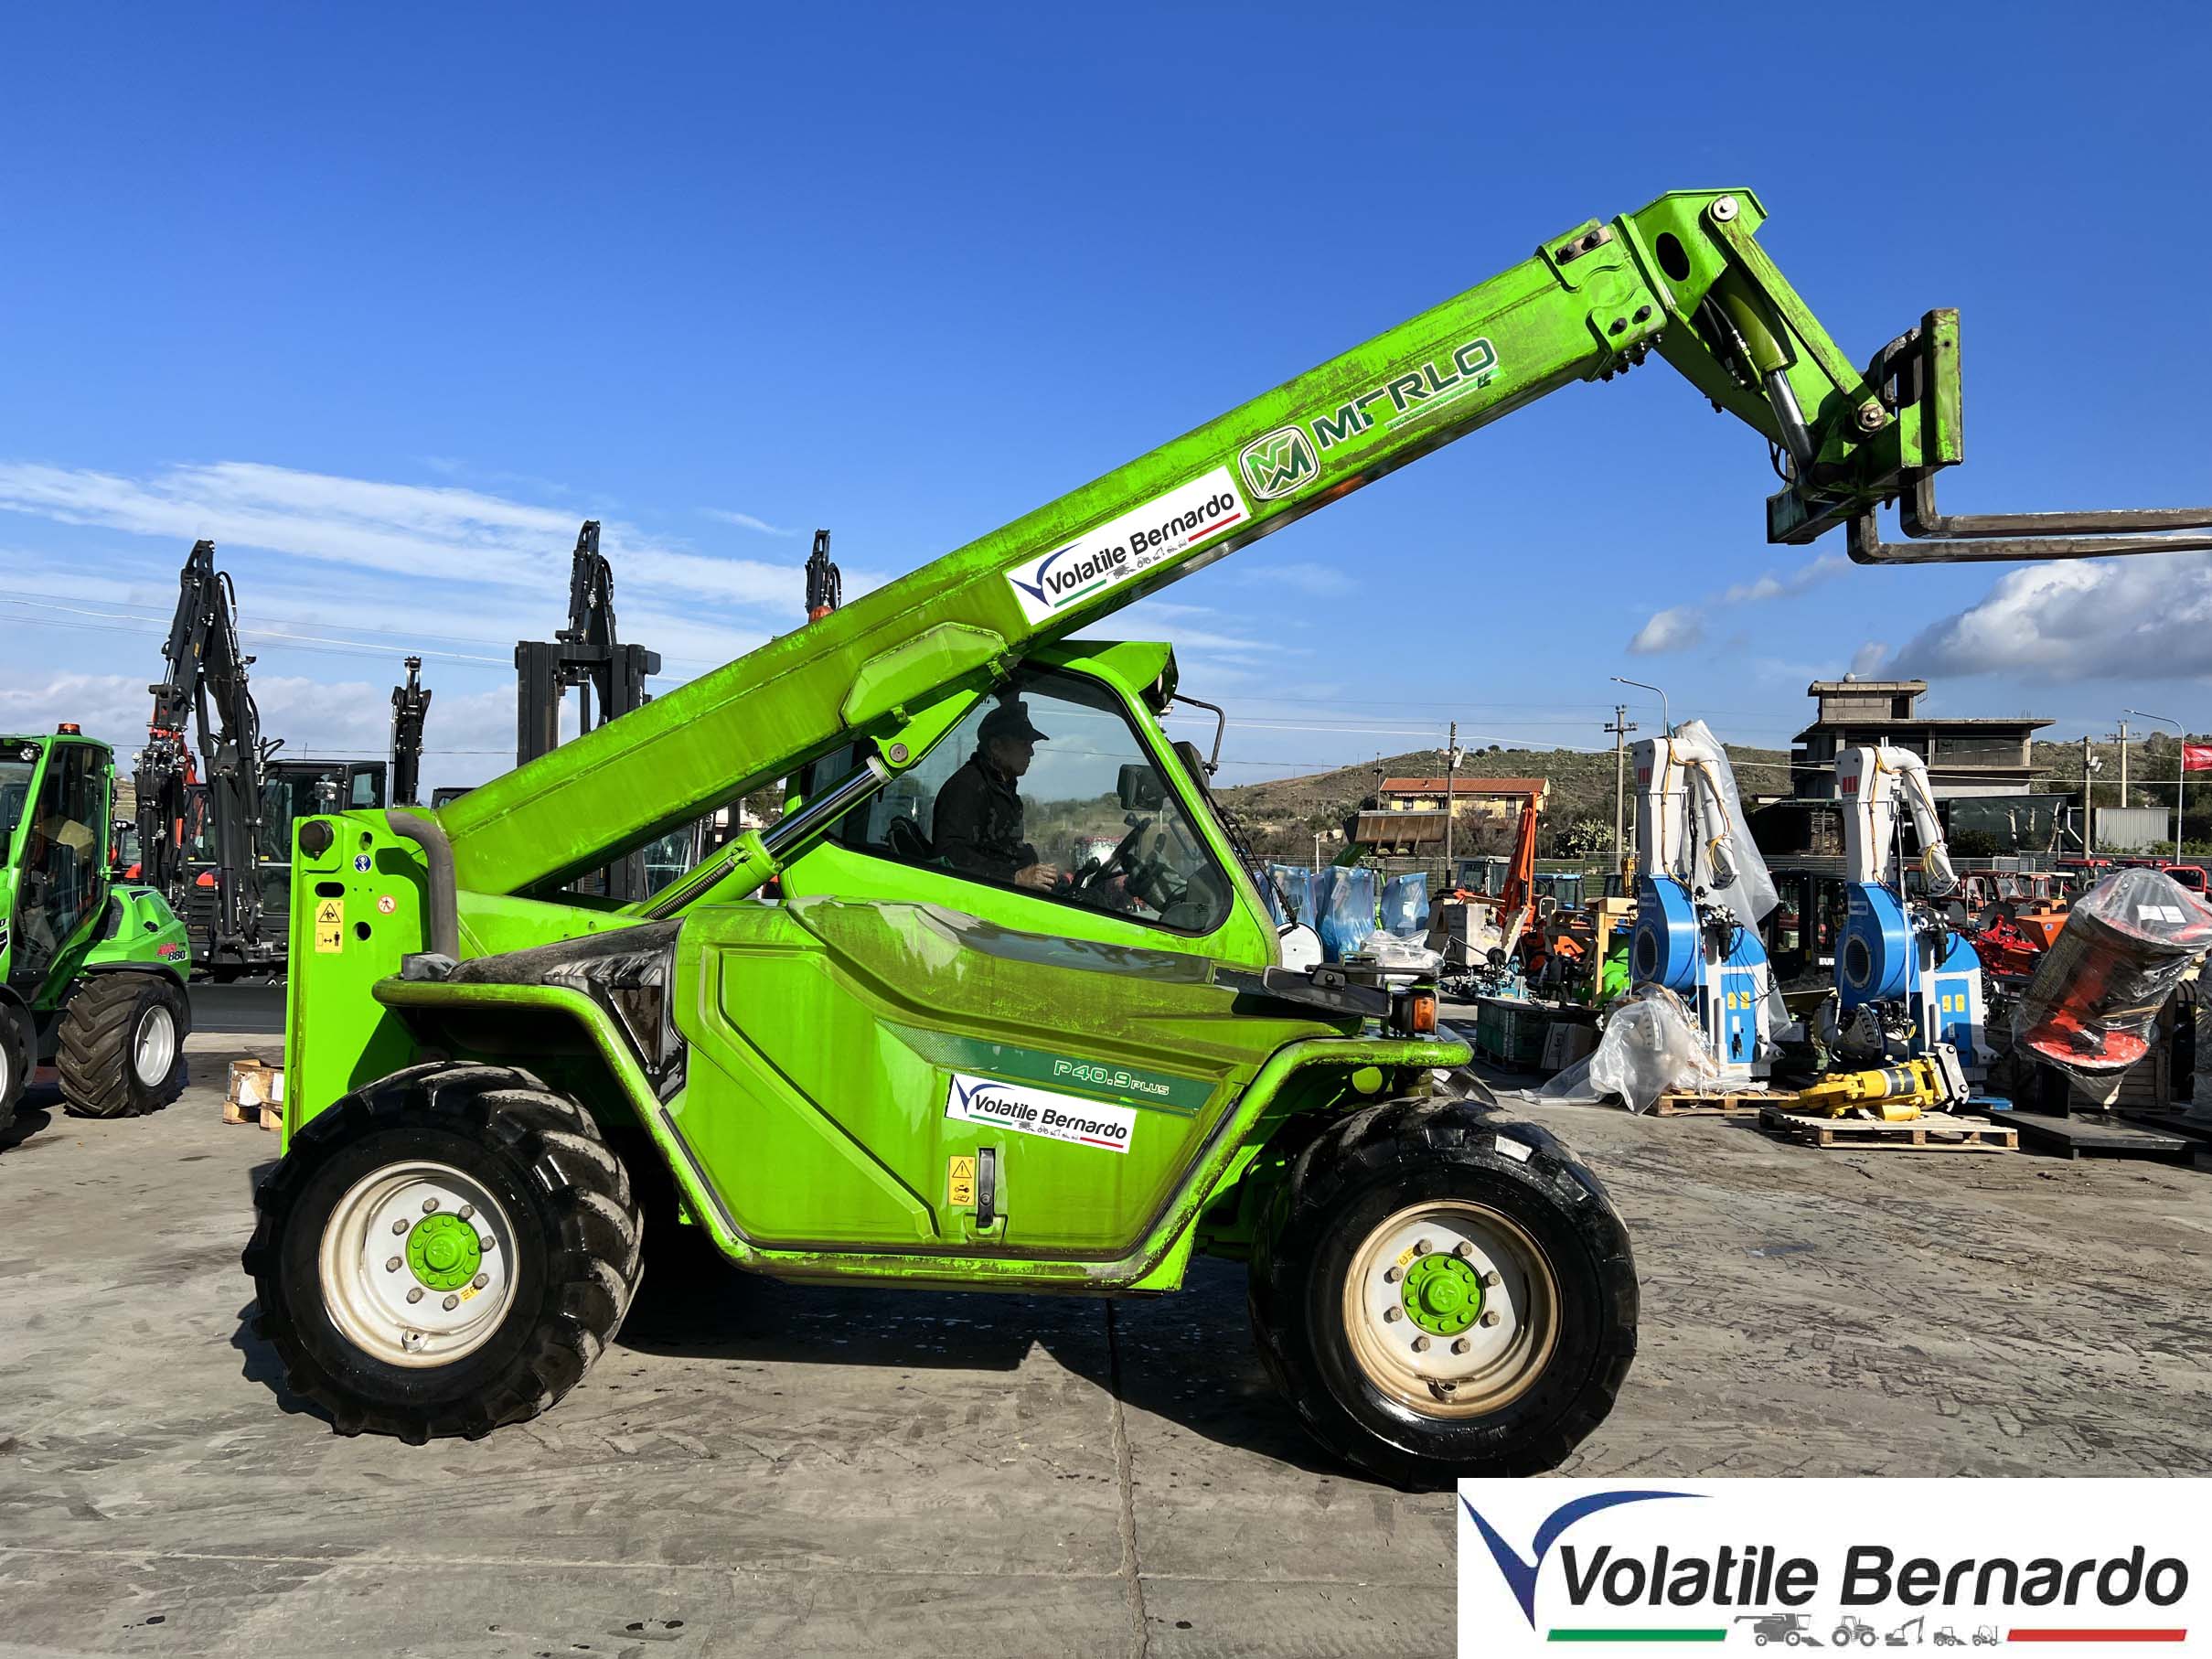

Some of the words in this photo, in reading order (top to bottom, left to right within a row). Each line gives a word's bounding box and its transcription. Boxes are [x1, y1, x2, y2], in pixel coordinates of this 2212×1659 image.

[1045, 544, 1127, 594] Volatile
[1129, 493, 1234, 556] Bernardo
[975, 1094, 1038, 1121] Volatile
[1041, 1108, 1127, 1140] Bernardo
